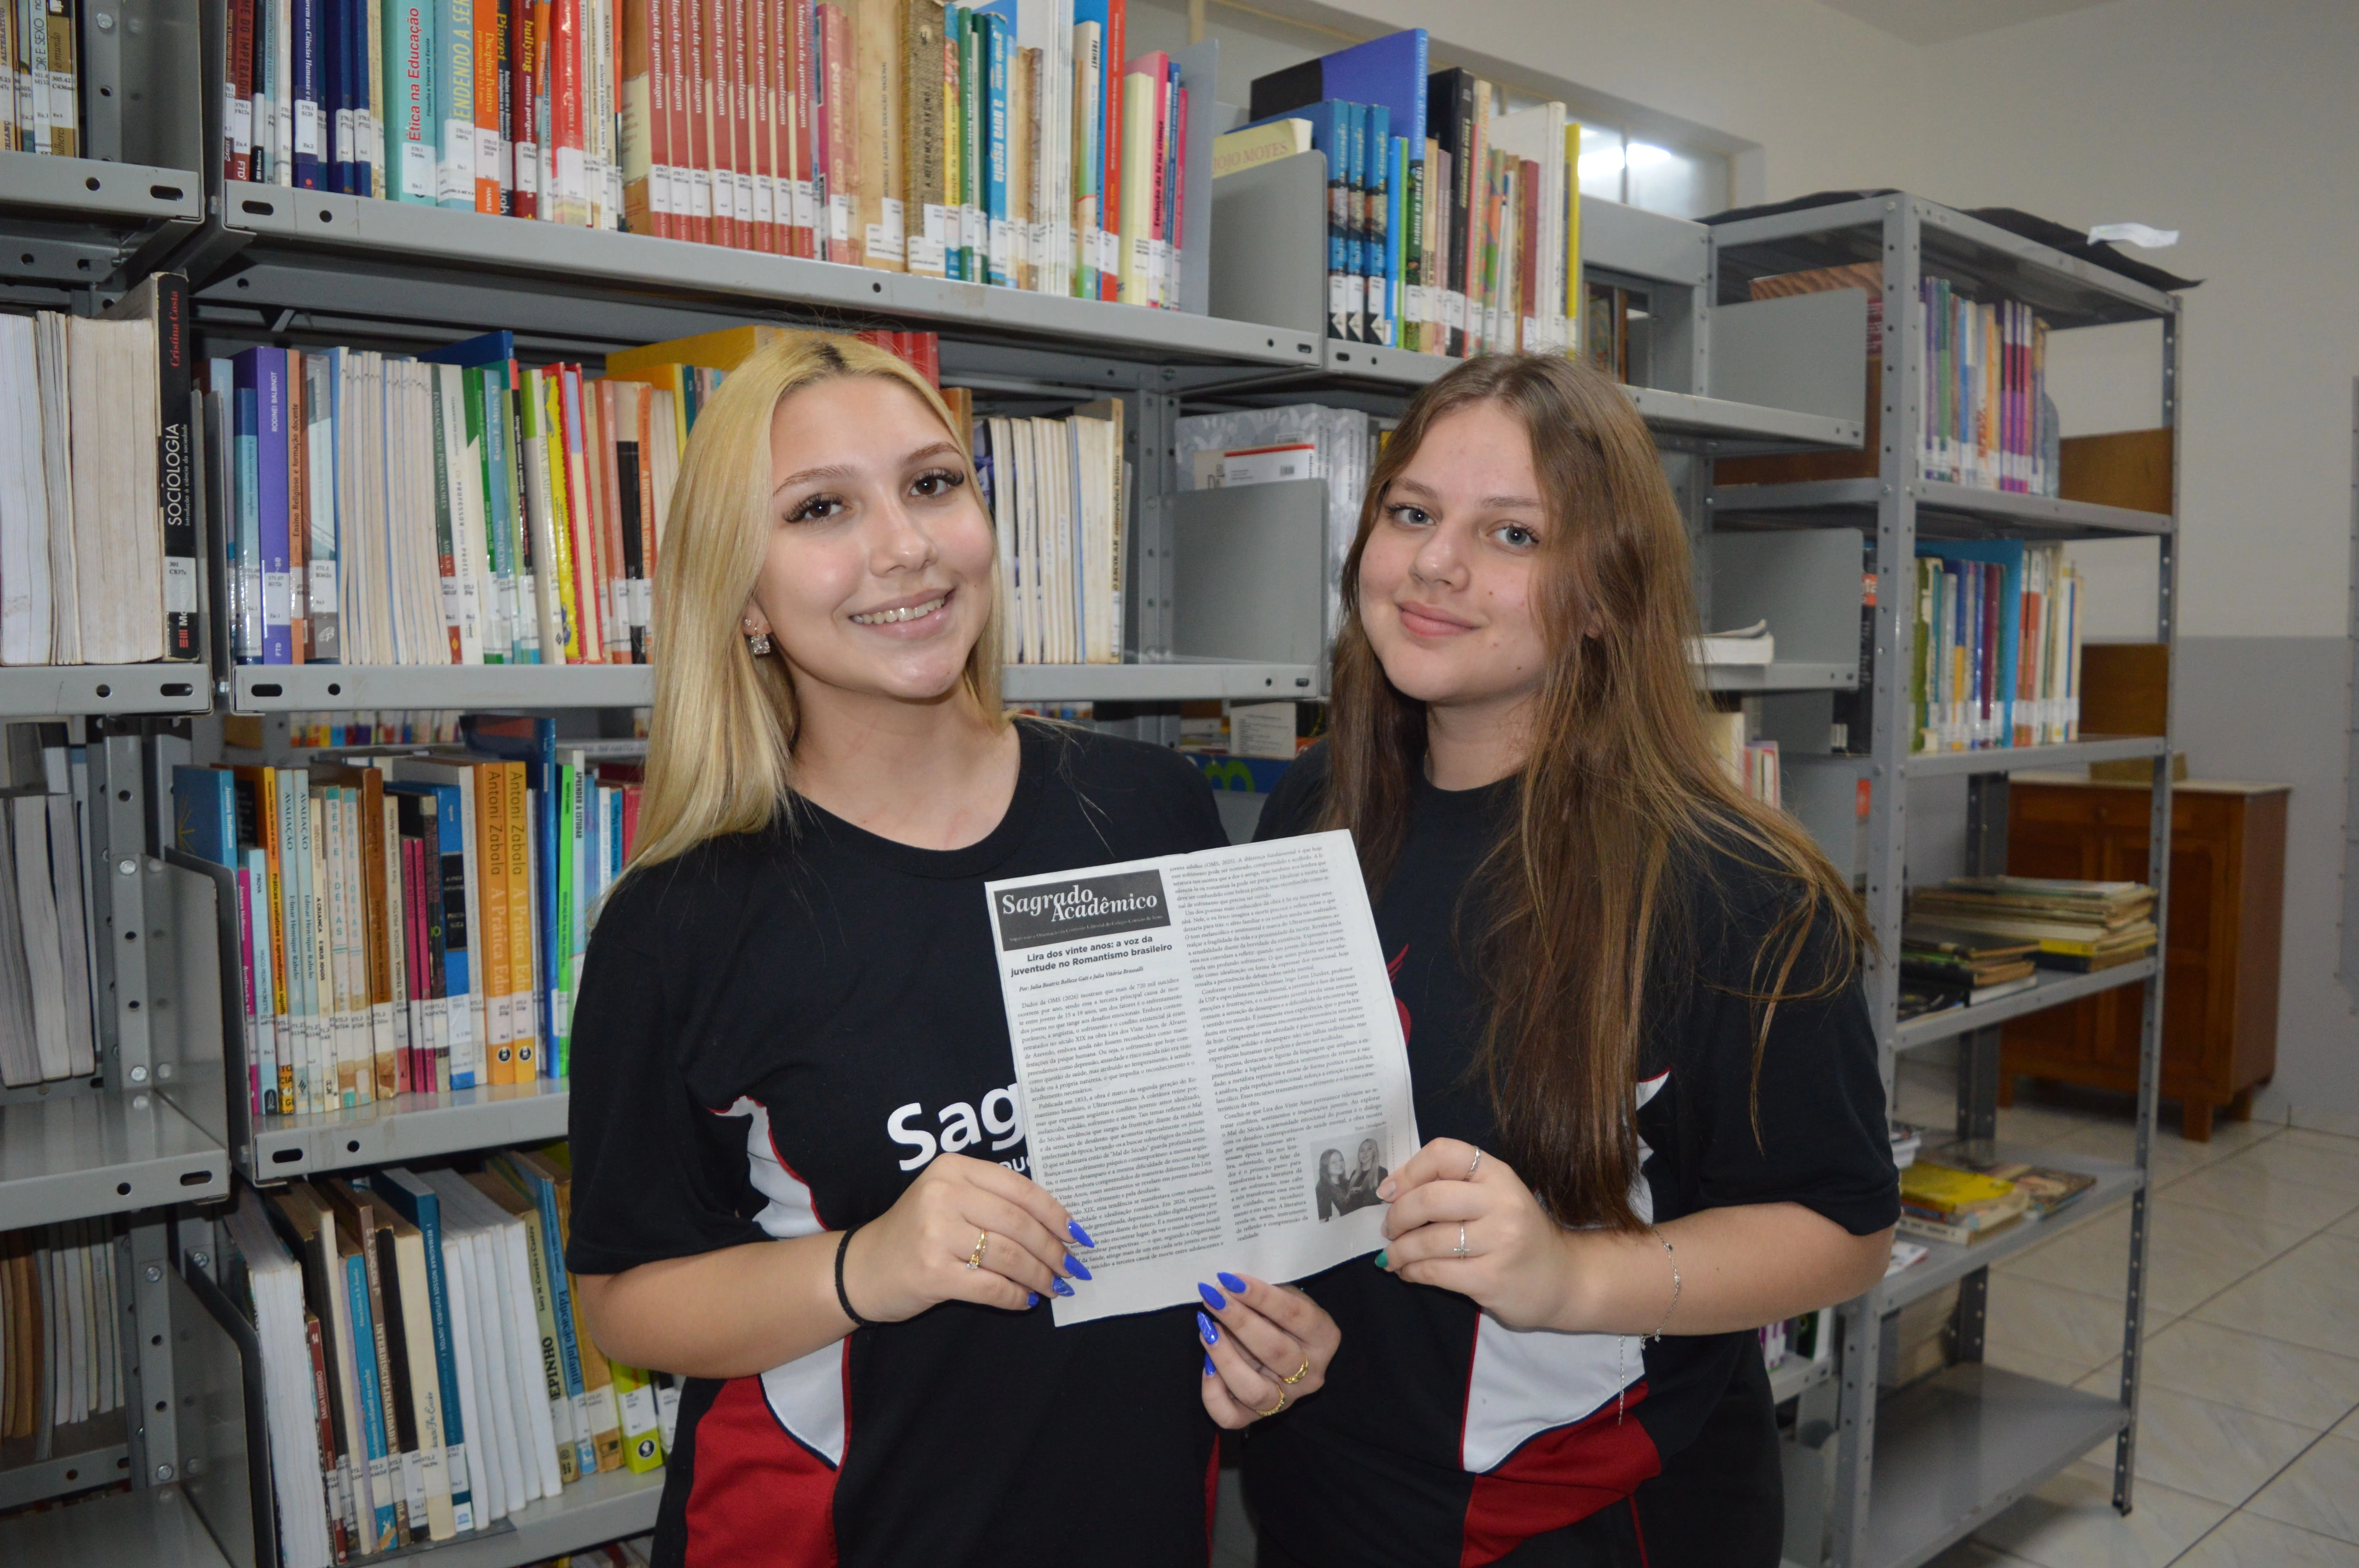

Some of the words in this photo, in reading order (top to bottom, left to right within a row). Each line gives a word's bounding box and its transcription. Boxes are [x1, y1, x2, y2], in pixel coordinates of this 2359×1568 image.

[34, 18, 45, 45] SEXO
[407, 7, 422, 79] Educação
[522, 20, 534, 72] bullying
[653, 28, 661, 42] da
[485, 33, 494, 76] Disciplina
[778, 43, 786, 57] da
[798, 46, 805, 60] da
[411, 83, 420, 99] na
[652, 44, 662, 109] aprendizagem
[485, 78, 494, 113] Positiva
[798, 62, 807, 128] aprendizagem
[405, 102, 420, 141] Ética
[993, 111, 1004, 140] nova
[237, 160, 246, 180] FTD
[169, 291, 178, 320] Costa
[169, 324, 180, 367] Cristina
[293, 434, 301, 468] formação
[165, 424, 182, 526] SOCIOLOGIA
[292, 477, 301, 510] Religioso
[642, 477, 650, 529] ENTREVISTA
[489, 771, 502, 820] Antoni
[510, 771, 524, 819] Antoni
[285, 792, 294, 850] AVALIAÇÃO
[300, 791, 309, 850] AVALIAÇÃO
[489, 824, 504, 876] Zabala
[511, 825, 525, 875] Zabala
[491, 887, 505, 900] A
[513, 887, 527, 900] A
[1002, 884, 1093, 916] Sagrado
[1051, 893, 1158, 922] Acadêmico
[491, 905, 507, 959] Prática
[513, 905, 529, 959] Prática
[1027, 951, 1044, 962] Lira
[1047, 949, 1063, 958] dos
[1065, 946, 1088, 955] vinte
[1090, 941, 1114, 951] anos:
[1141, 935, 1152, 943] da
[276, 944, 284, 992] aprendizagens
[1010, 961, 1056, 977] juventude
[1072, 952, 1129, 965] Romantismo
[1131, 944, 1172, 956] brasileiro
[1123, 965, 1144, 975] Brassalli
[1232, 982, 1260, 991] psicanalista
[1331, 966, 1353, 975] professor
[1062, 993, 1079, 1002] (2026)
[1120, 991, 1142, 1002] principal
[434, 1296, 443, 1325] FUTUROS
[558, 1291, 571, 1342] Educação
[567, 1345, 581, 1384] Infantil
